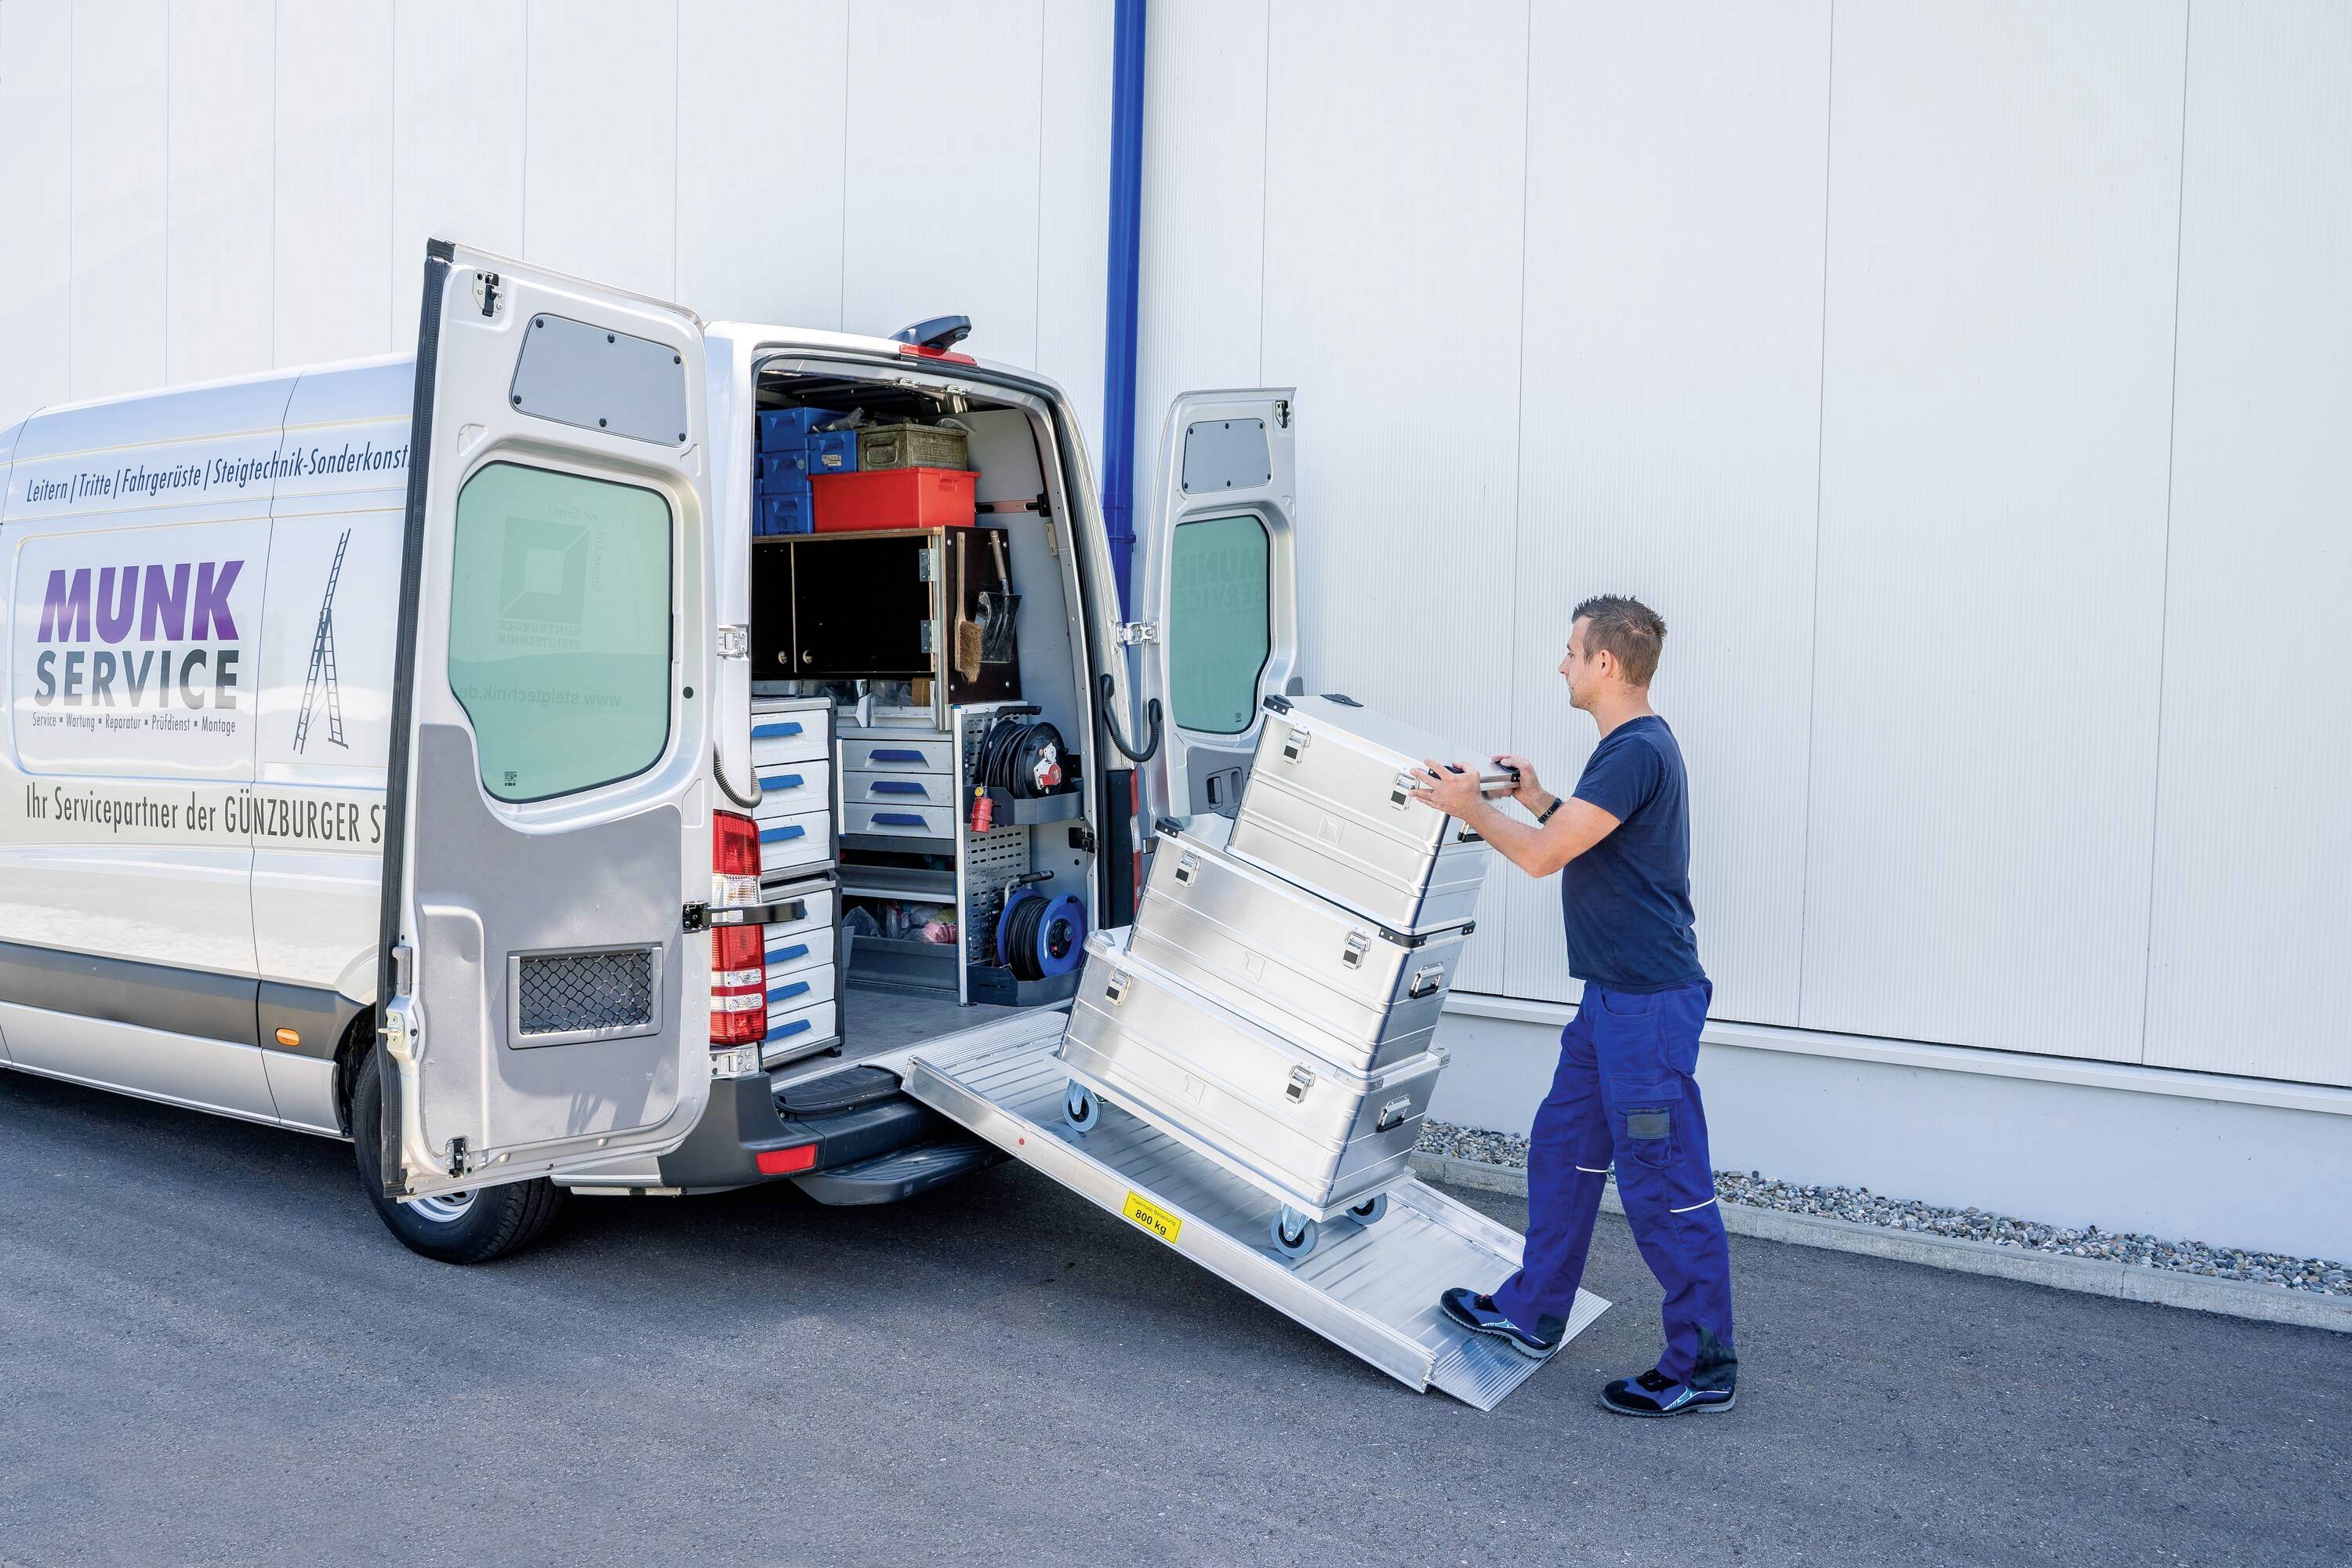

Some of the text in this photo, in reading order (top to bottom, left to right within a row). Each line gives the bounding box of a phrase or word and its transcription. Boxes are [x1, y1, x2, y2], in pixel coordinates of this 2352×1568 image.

[27, 441, 409, 502] Leitern Tritte Fahrgerüste Steigtechnik-Sonderkonst
[37, 561, 245, 644] MUNK
[34, 648, 239, 710] SERVICE
[32, 712, 236, 736] Service Wartung Reparatur Prüfdienst Montage
[27, 782, 48, 818] Ihr
[54, 786, 178, 833] Servicepartner
[187, 791, 216, 833] der
[224, 789, 360, 842] GÜNZBURGER
[1131, 1197, 1176, 1226] maximale Belastung
[1135, 1210, 1167, 1236] 800 kg
